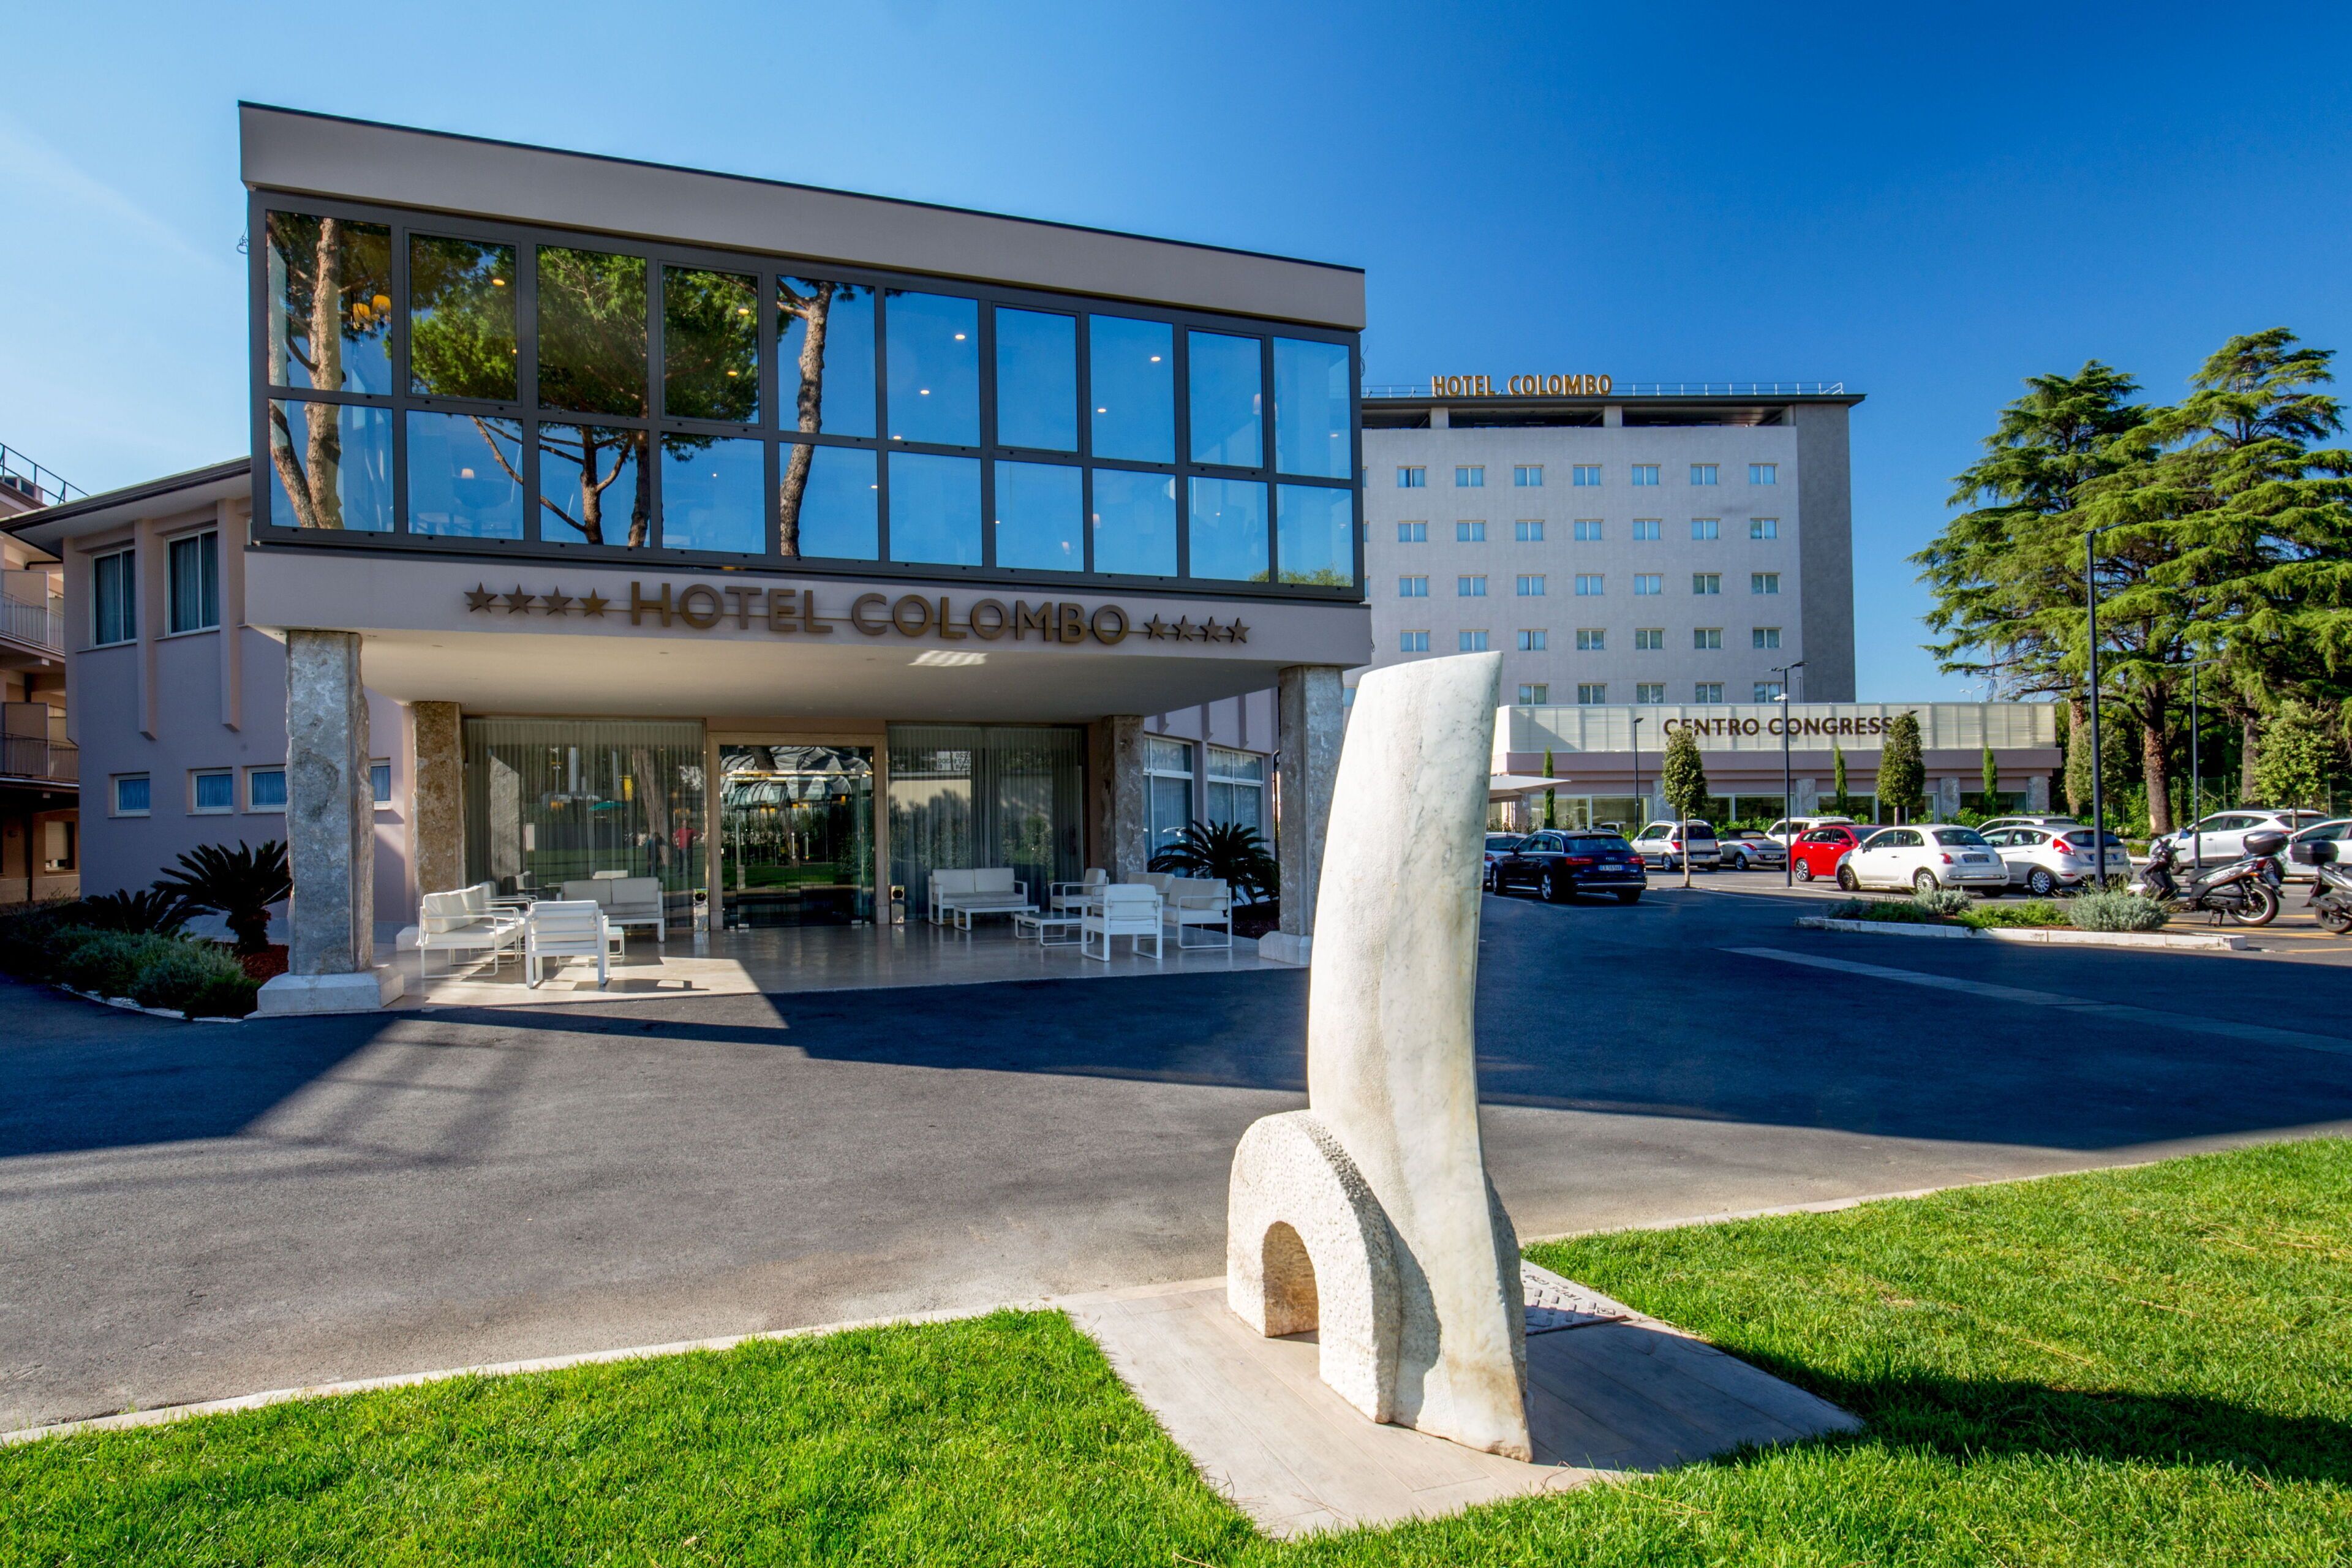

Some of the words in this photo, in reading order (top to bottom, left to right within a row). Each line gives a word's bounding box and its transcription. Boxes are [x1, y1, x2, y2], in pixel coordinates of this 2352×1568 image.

[1432, 375, 1496, 397] HOTEL
[1507, 374, 1612, 396] COLOMBO
[630, 581, 833, 633] HOTEL
[851, 592, 1130, 645] COLOMBO
[1766, 716, 1894, 736] CONGRESS
